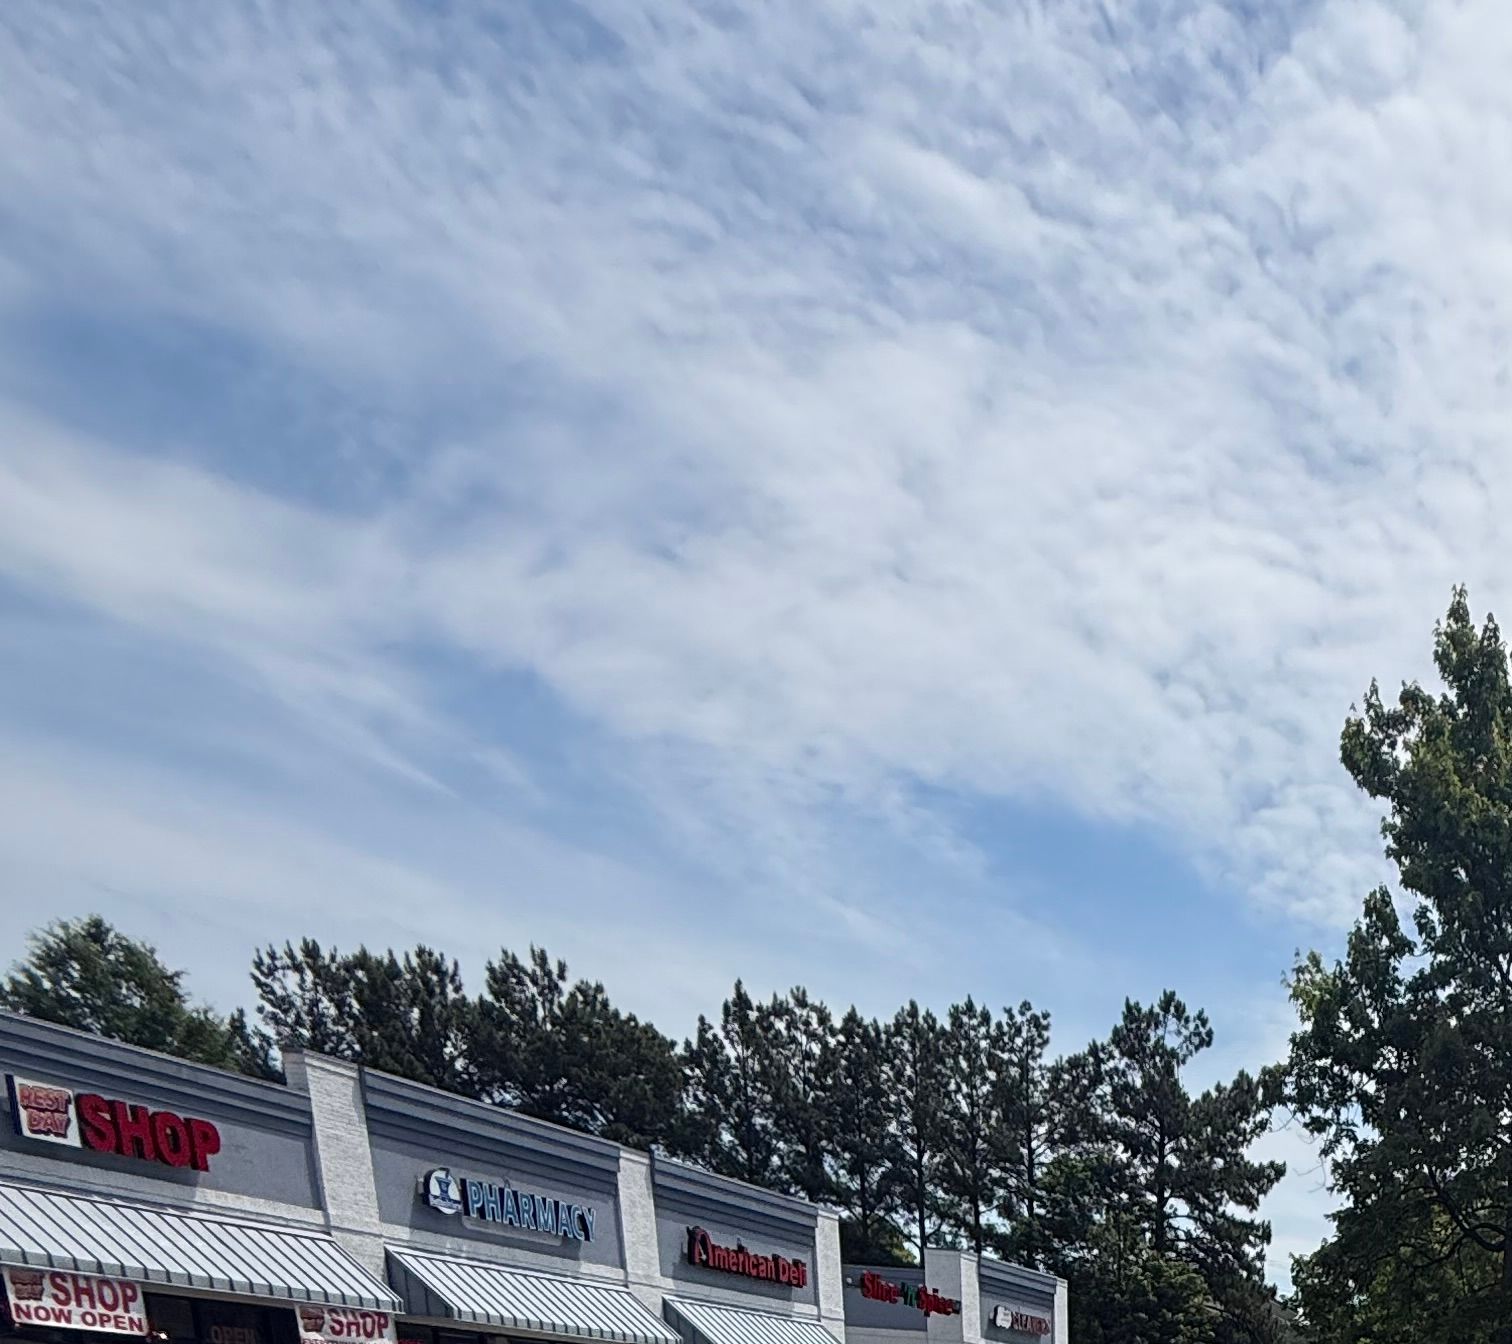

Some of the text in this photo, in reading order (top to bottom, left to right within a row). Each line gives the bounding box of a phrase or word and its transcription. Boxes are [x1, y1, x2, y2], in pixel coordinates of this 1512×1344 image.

[78, 1093, 220, 1171] SHOP
[465, 1179, 597, 1241] PHARMACY
[690, 1226, 808, 1288] American Deli
[13, 1303, 144, 1333] NOW OPEN
[50, 1271, 138, 1314] SHOP
[328, 1307, 389, 1339] SHOP
